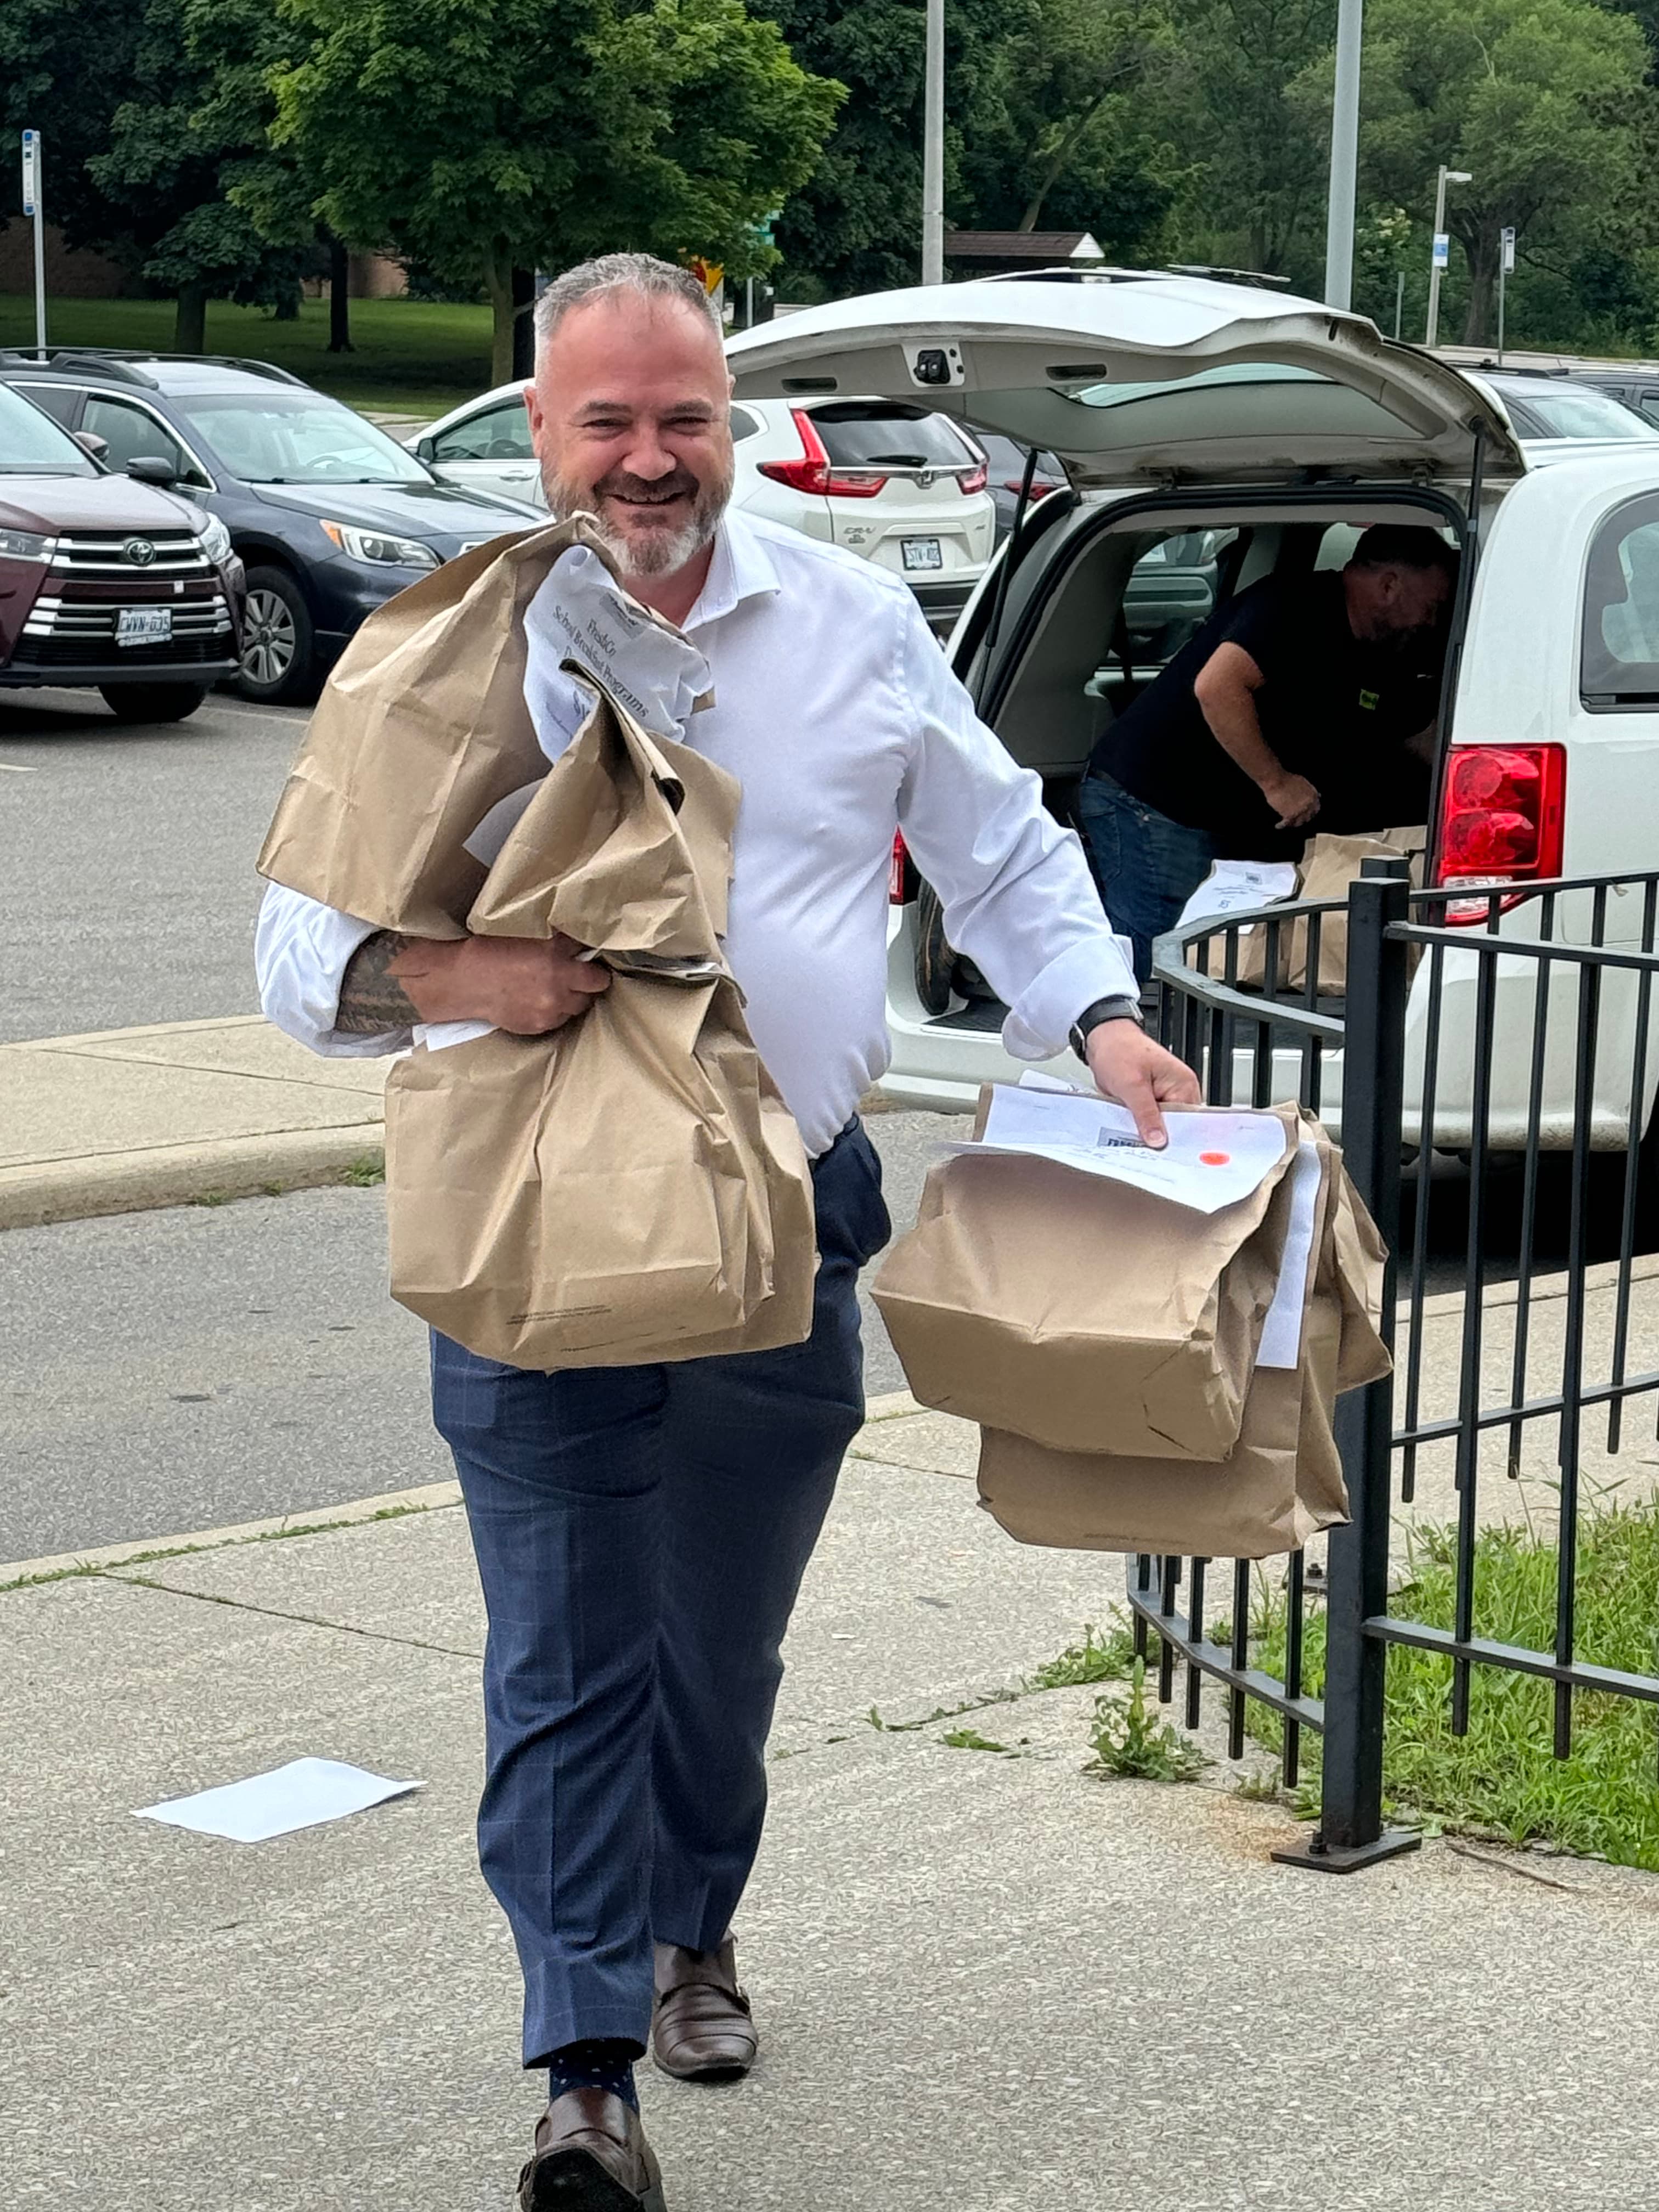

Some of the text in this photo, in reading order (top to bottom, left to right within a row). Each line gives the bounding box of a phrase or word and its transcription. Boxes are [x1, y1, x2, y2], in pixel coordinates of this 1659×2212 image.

[553, 605, 577, 638] School
[574, 629, 604, 674] Breakfast
[603, 664, 650, 718] Programs
